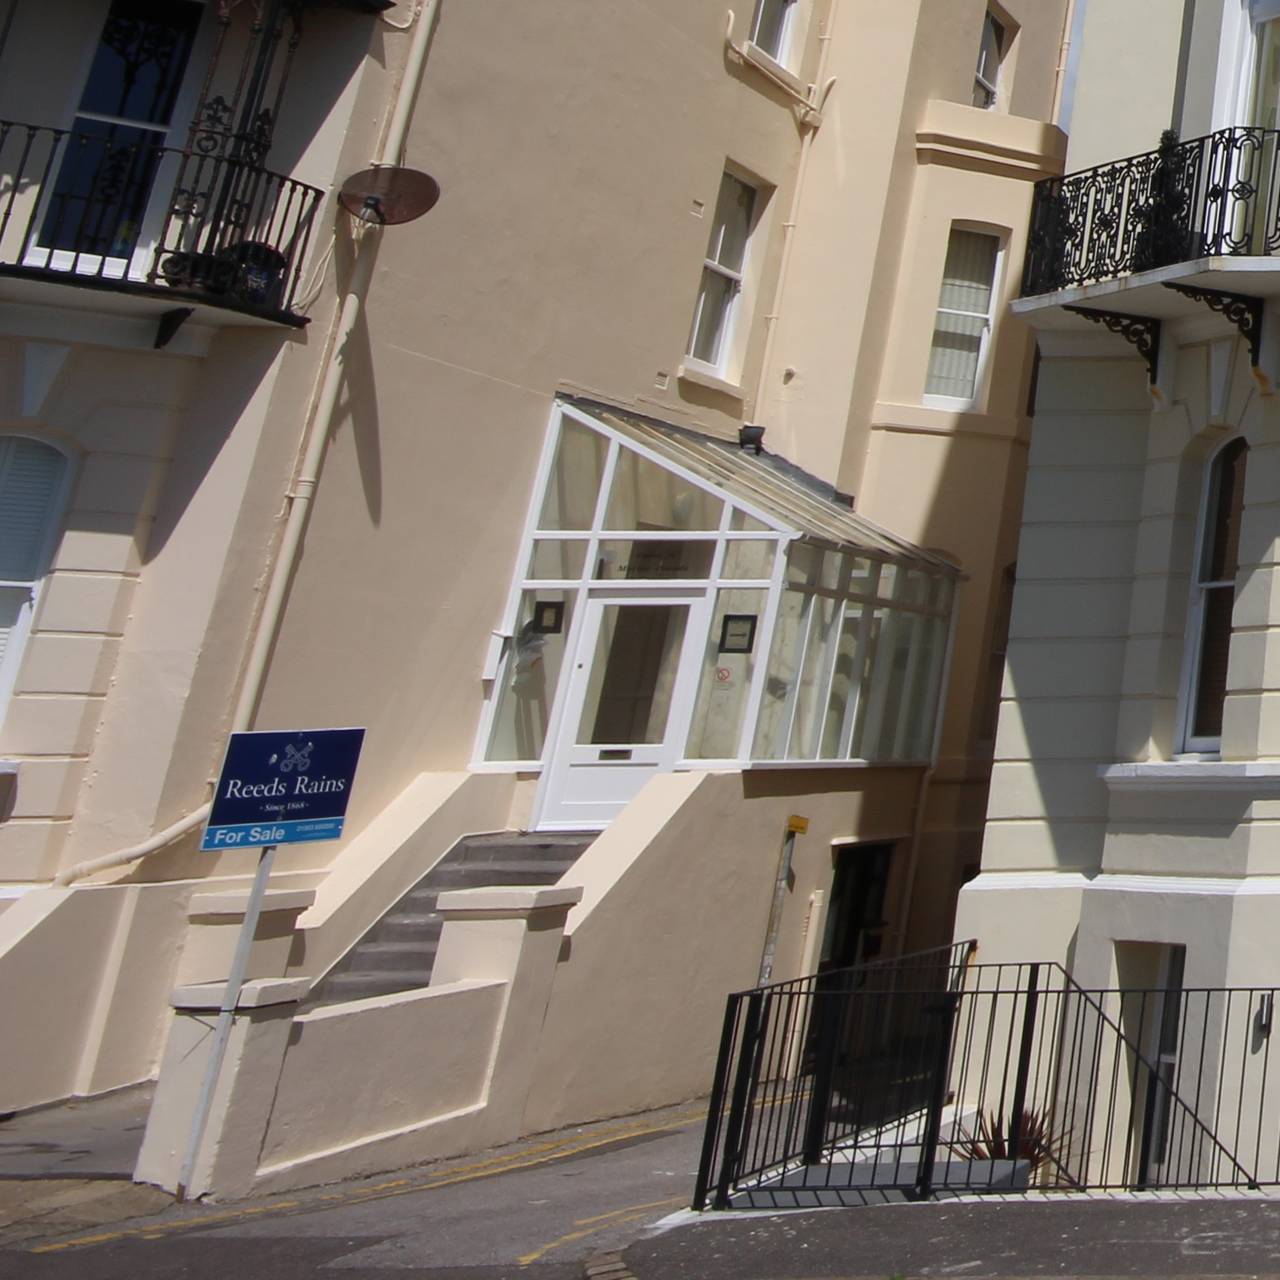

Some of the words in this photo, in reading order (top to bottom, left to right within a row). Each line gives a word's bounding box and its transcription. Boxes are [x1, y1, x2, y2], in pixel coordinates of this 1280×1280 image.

[224, 777, 288, 799] Reeds
[293, 775, 346, 795] Rains
[214, 829, 245, 845] For
[248, 826, 285, 842] Sale
